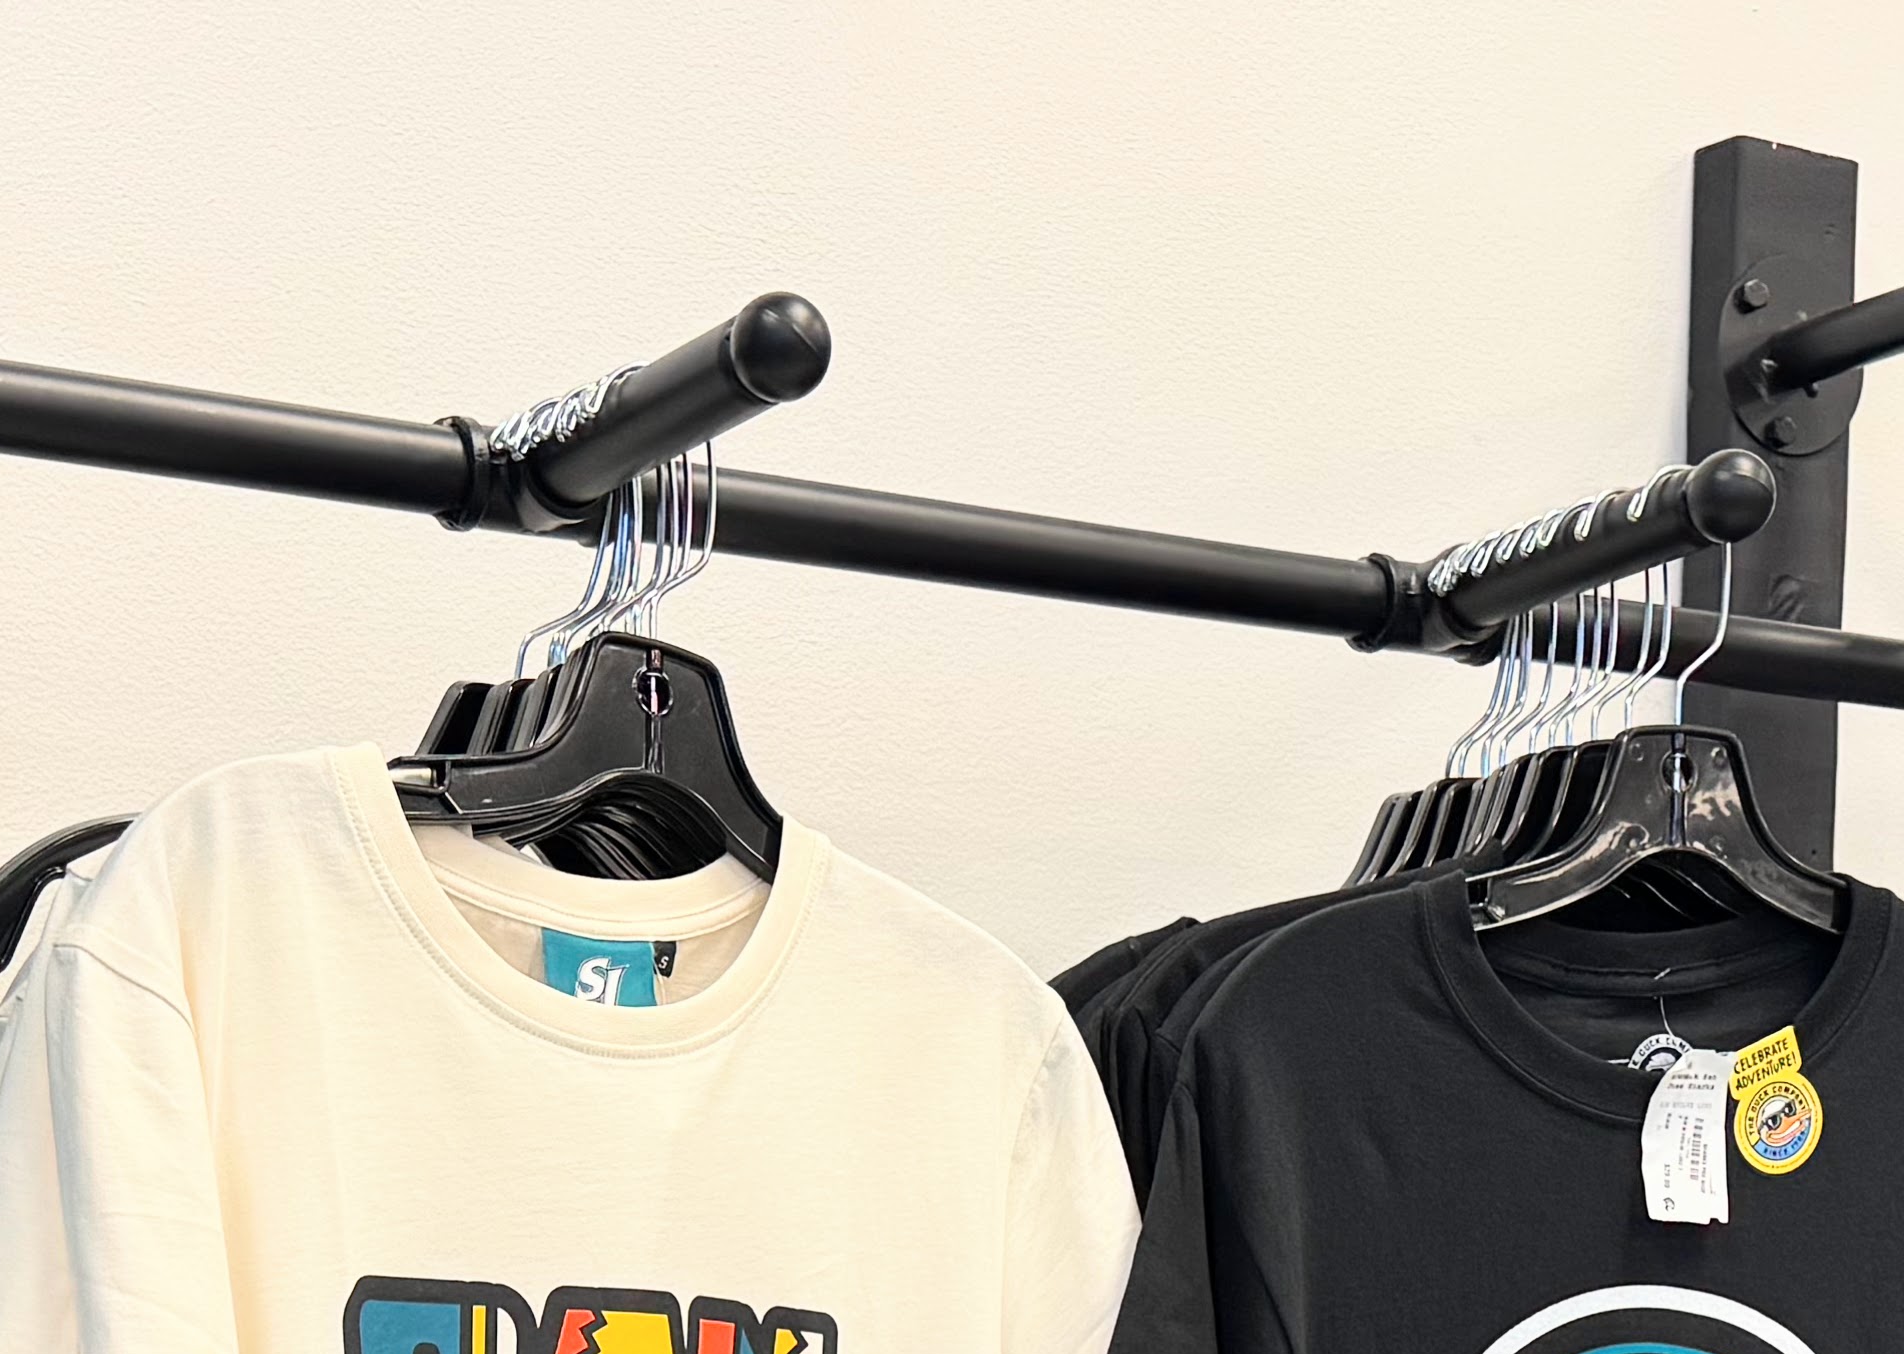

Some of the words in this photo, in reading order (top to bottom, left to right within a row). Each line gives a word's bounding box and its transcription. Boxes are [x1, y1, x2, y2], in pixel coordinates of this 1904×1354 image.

[659, 956, 669, 969] S
[1734, 1038, 1789, 1074] CELEBRATE
[1735, 1052, 1797, 1091] ADVENTURE!
